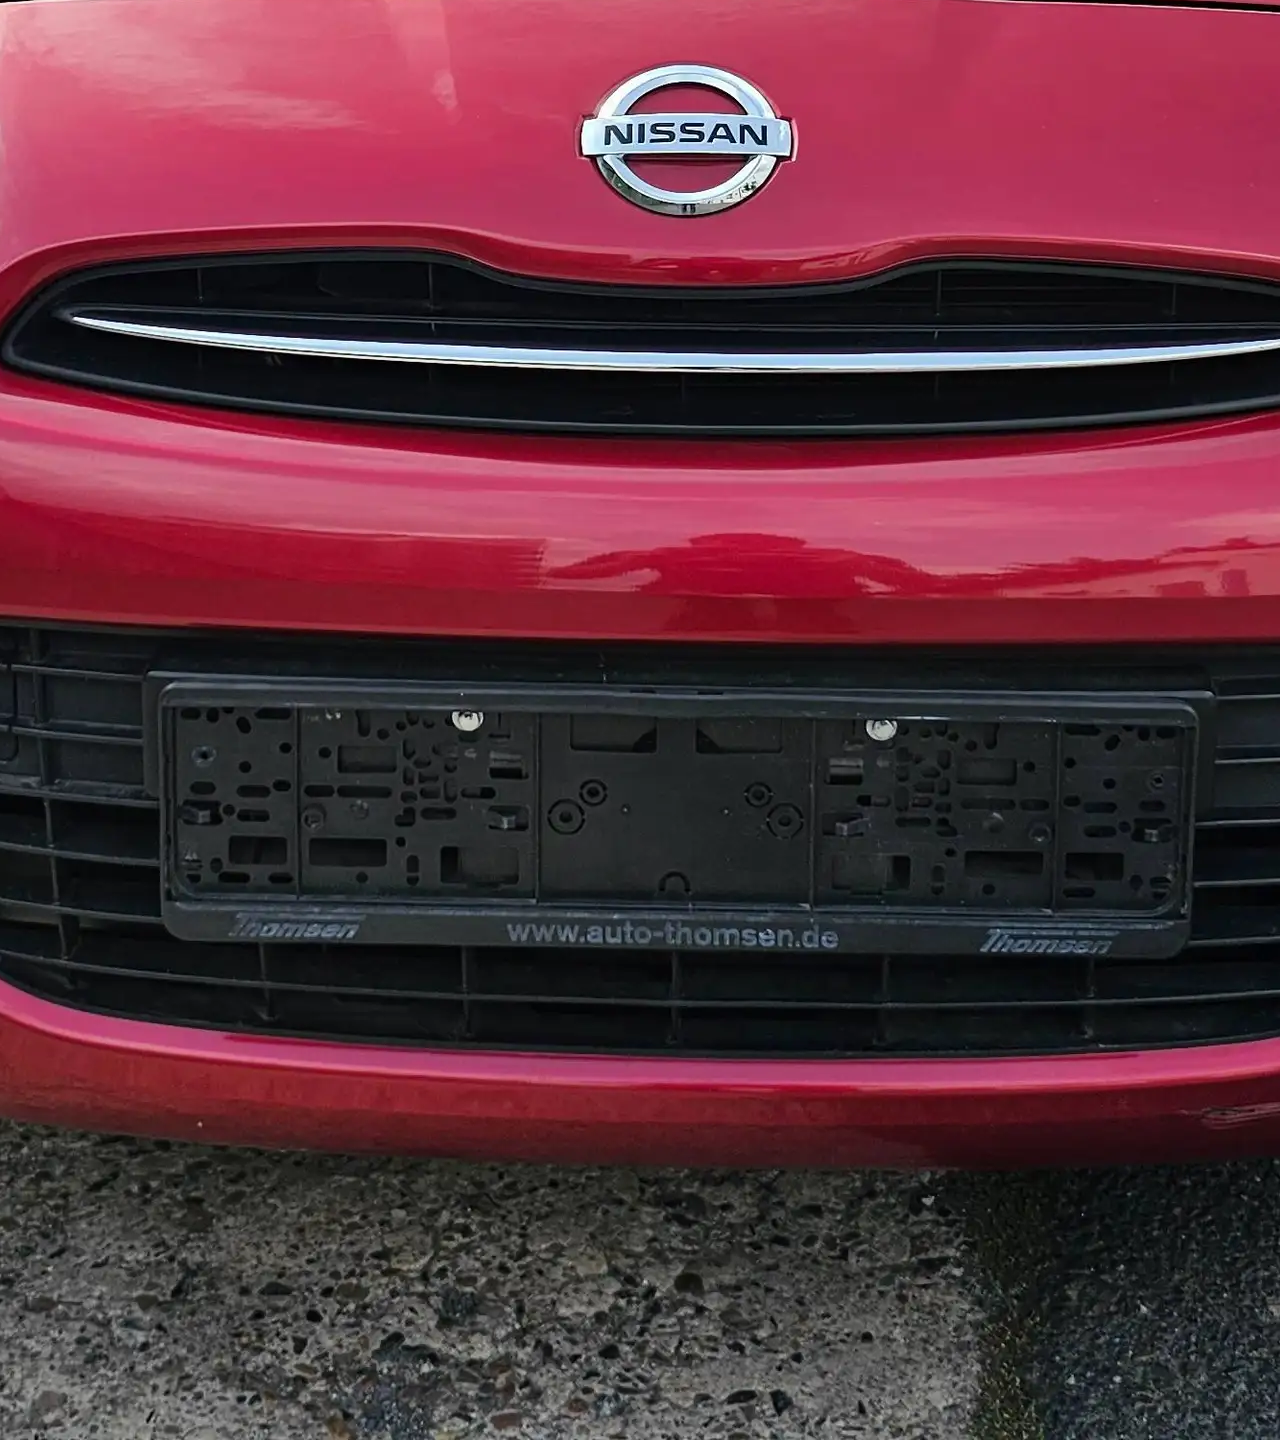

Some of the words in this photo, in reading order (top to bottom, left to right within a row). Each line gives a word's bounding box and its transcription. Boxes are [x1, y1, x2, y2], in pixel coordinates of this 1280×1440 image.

[604, 122, 768, 146] NISSAN
[228, 912, 367, 939] Thomsen
[507, 921, 840, 949] www.auto-thomsen.de
[980, 927, 1120, 954] Thomsen
